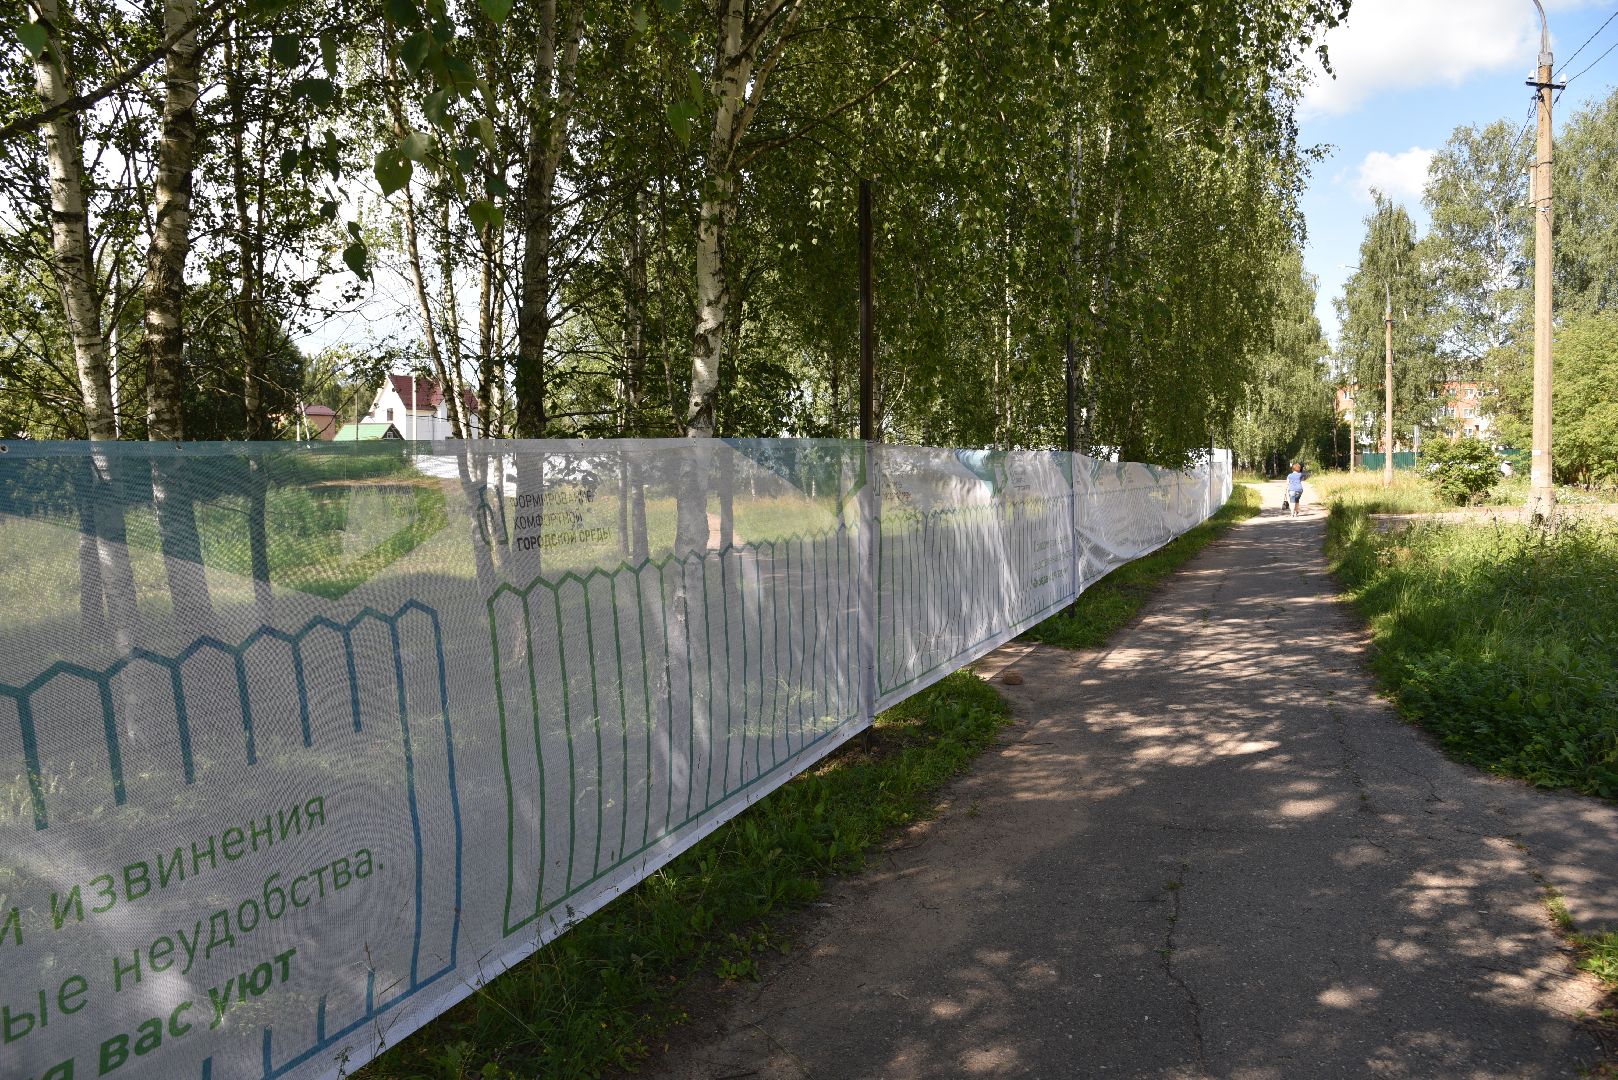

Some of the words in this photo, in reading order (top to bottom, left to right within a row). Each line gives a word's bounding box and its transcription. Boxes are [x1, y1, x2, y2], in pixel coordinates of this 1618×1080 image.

[514, 507, 583, 530] КОМФОРТНОЙ
[516, 528, 576, 551] ГОРОДСКОЙ
[580, 527, 611, 542] СРЕДЫ
[50, 796, 325, 930] извинения
[3, 975, 88, 1043] ые
[113, 848, 384, 992] неудобства.
[99, 1000, 193, 1077] вас
[208, 947, 297, 1029] уют
